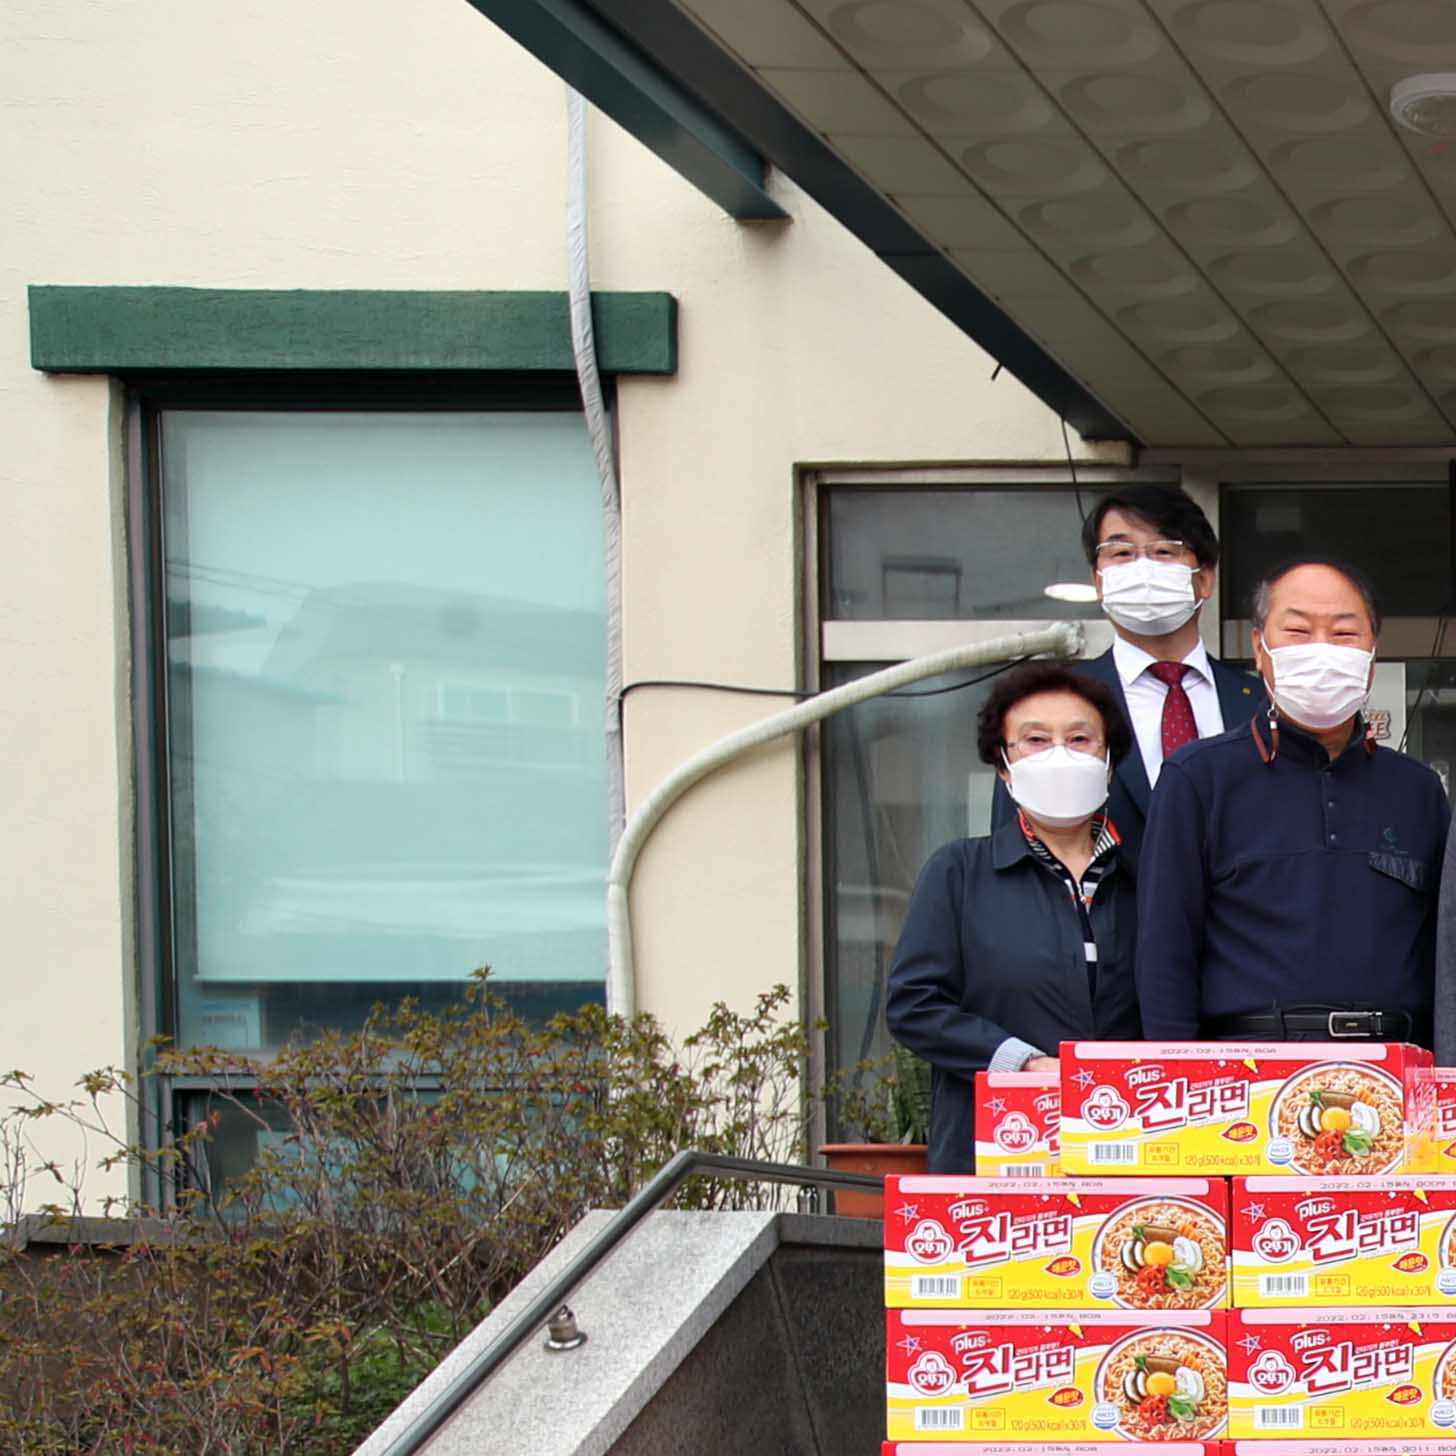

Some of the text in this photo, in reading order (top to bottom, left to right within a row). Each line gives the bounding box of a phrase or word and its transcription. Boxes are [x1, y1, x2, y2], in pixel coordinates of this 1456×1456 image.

[1133, 1078, 1249, 1133] 진라면
[958, 1212, 1072, 1266] 진라면
[1305, 1210, 1419, 1264] 진라면
[960, 1344, 1074, 1398] 진라면
[1299, 1342, 1413, 1396] 진라면
